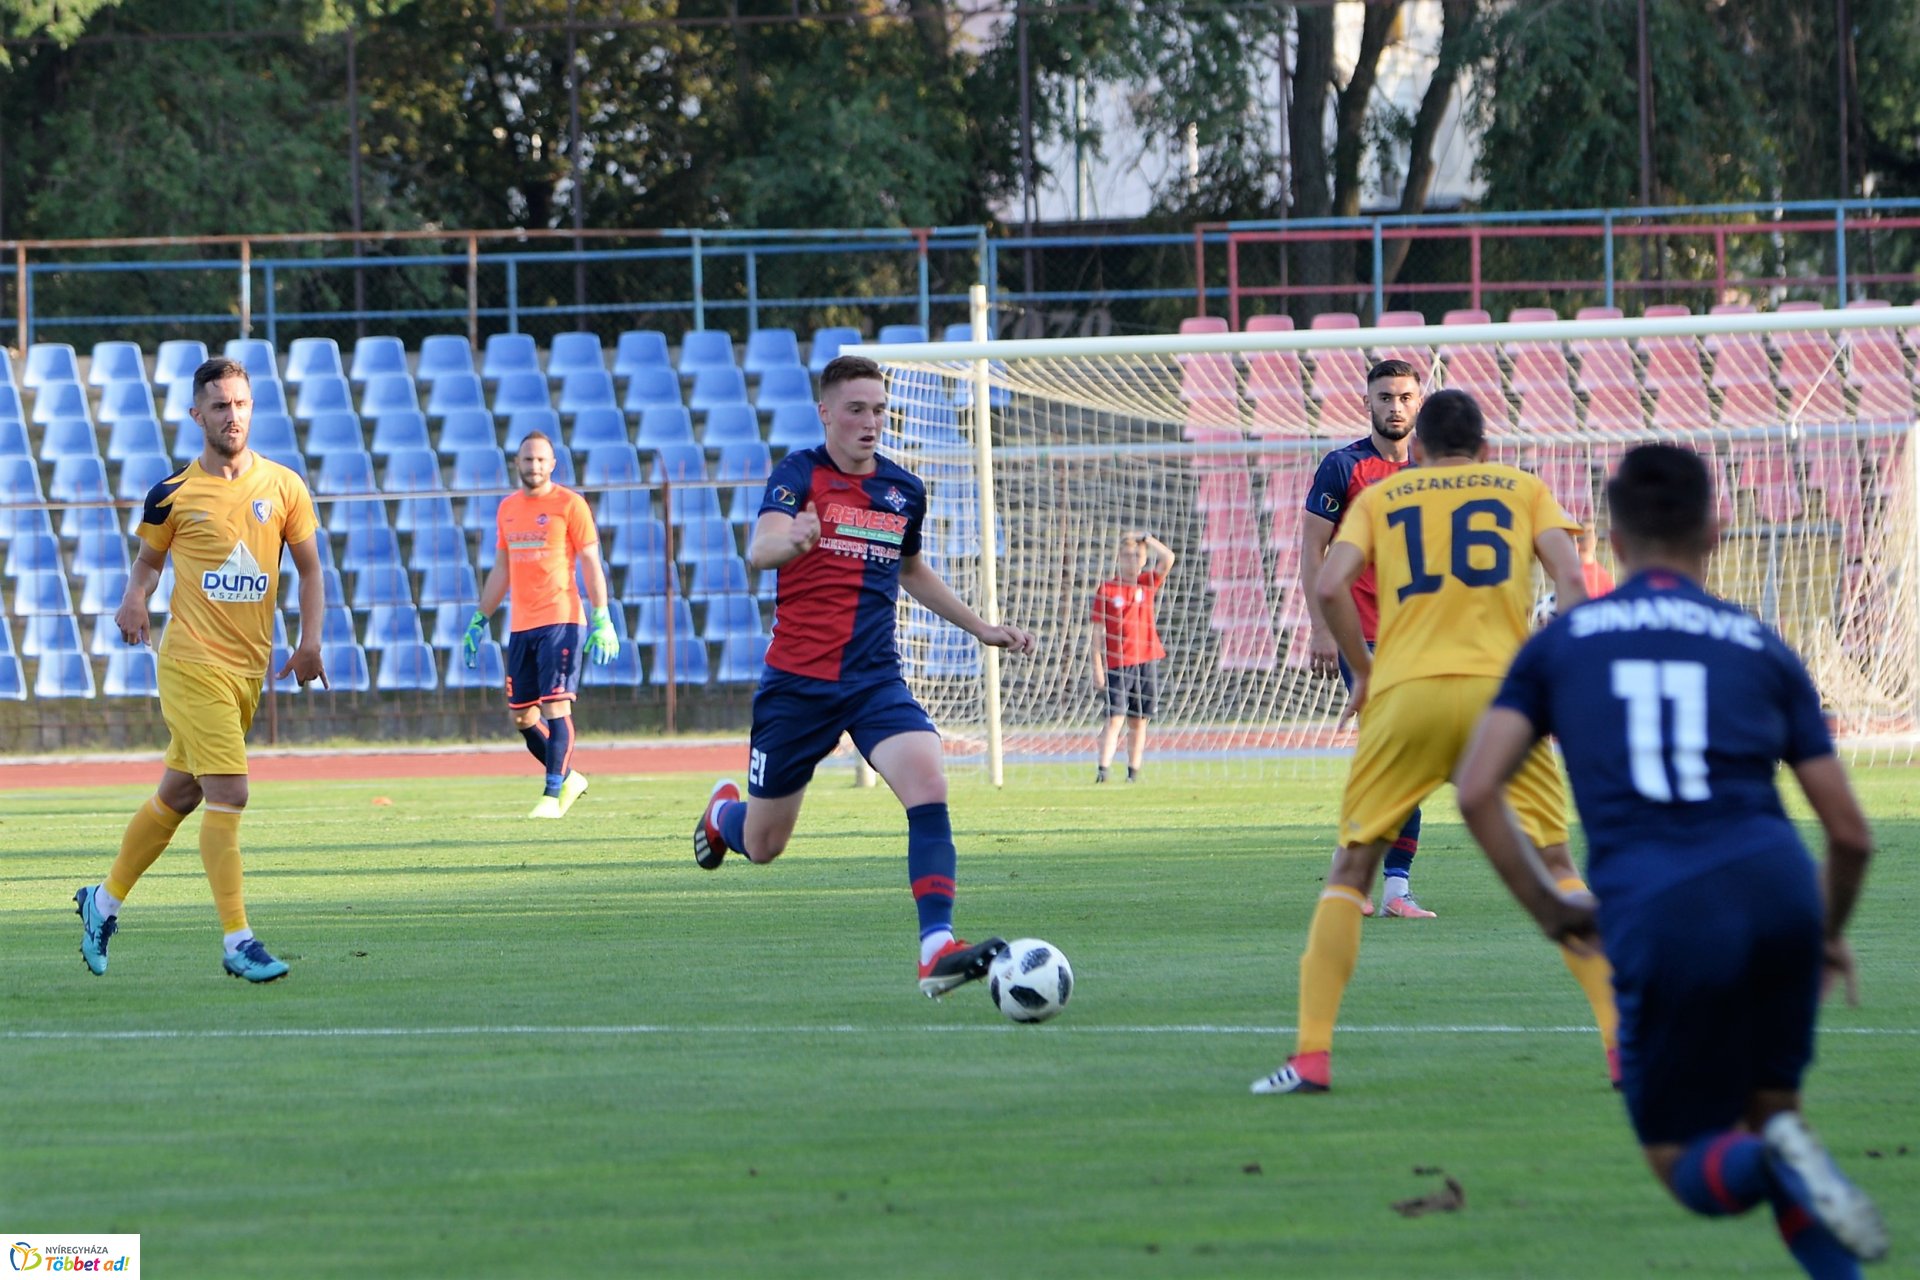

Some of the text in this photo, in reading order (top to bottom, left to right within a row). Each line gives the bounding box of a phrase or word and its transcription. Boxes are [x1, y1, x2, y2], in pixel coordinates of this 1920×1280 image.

[1386, 499, 1513, 603] 16
[210, 591, 262, 601] ASZFALT
[1611, 658, 1712, 802] 11
[749, 747, 767, 787] 21
